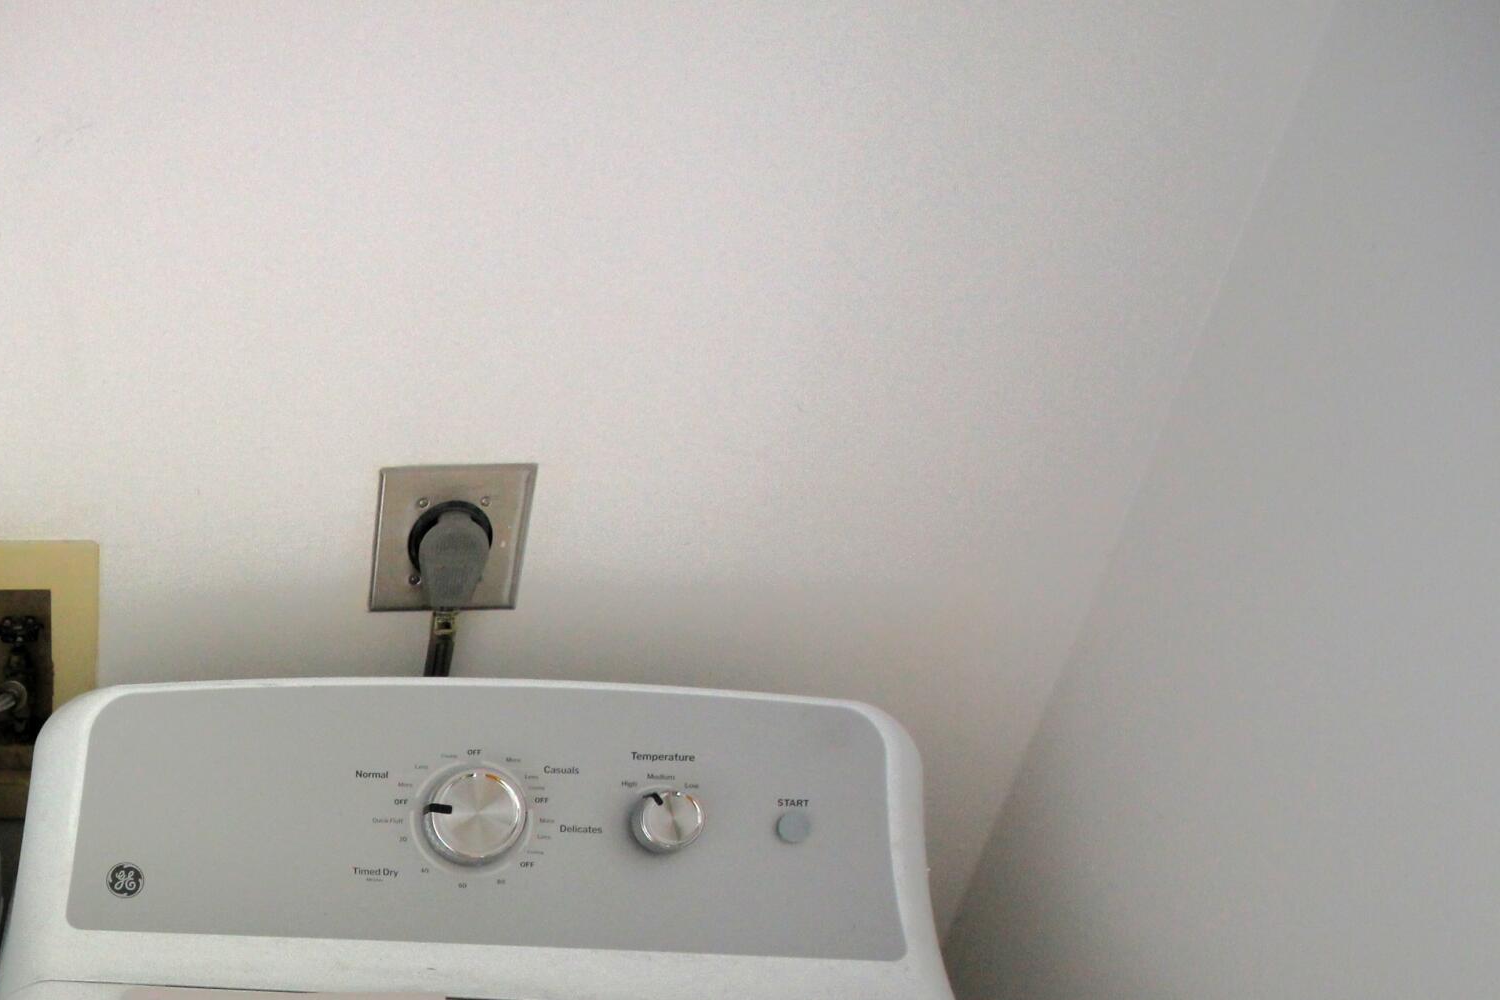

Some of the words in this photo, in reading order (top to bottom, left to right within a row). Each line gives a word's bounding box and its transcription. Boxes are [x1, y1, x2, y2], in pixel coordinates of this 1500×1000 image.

[631, 751, 696, 763] Temperature
[355, 770, 389, 779] Normal
[543, 765, 580, 775] Casuals
[646, 773, 676, 781] Medium
[621, 780, 638, 788] High
[777, 798, 809, 808] START
[559, 824, 603, 835] Delicates
[353, 867, 381, 877] Timed
[382, 868, 399, 878] Dry
